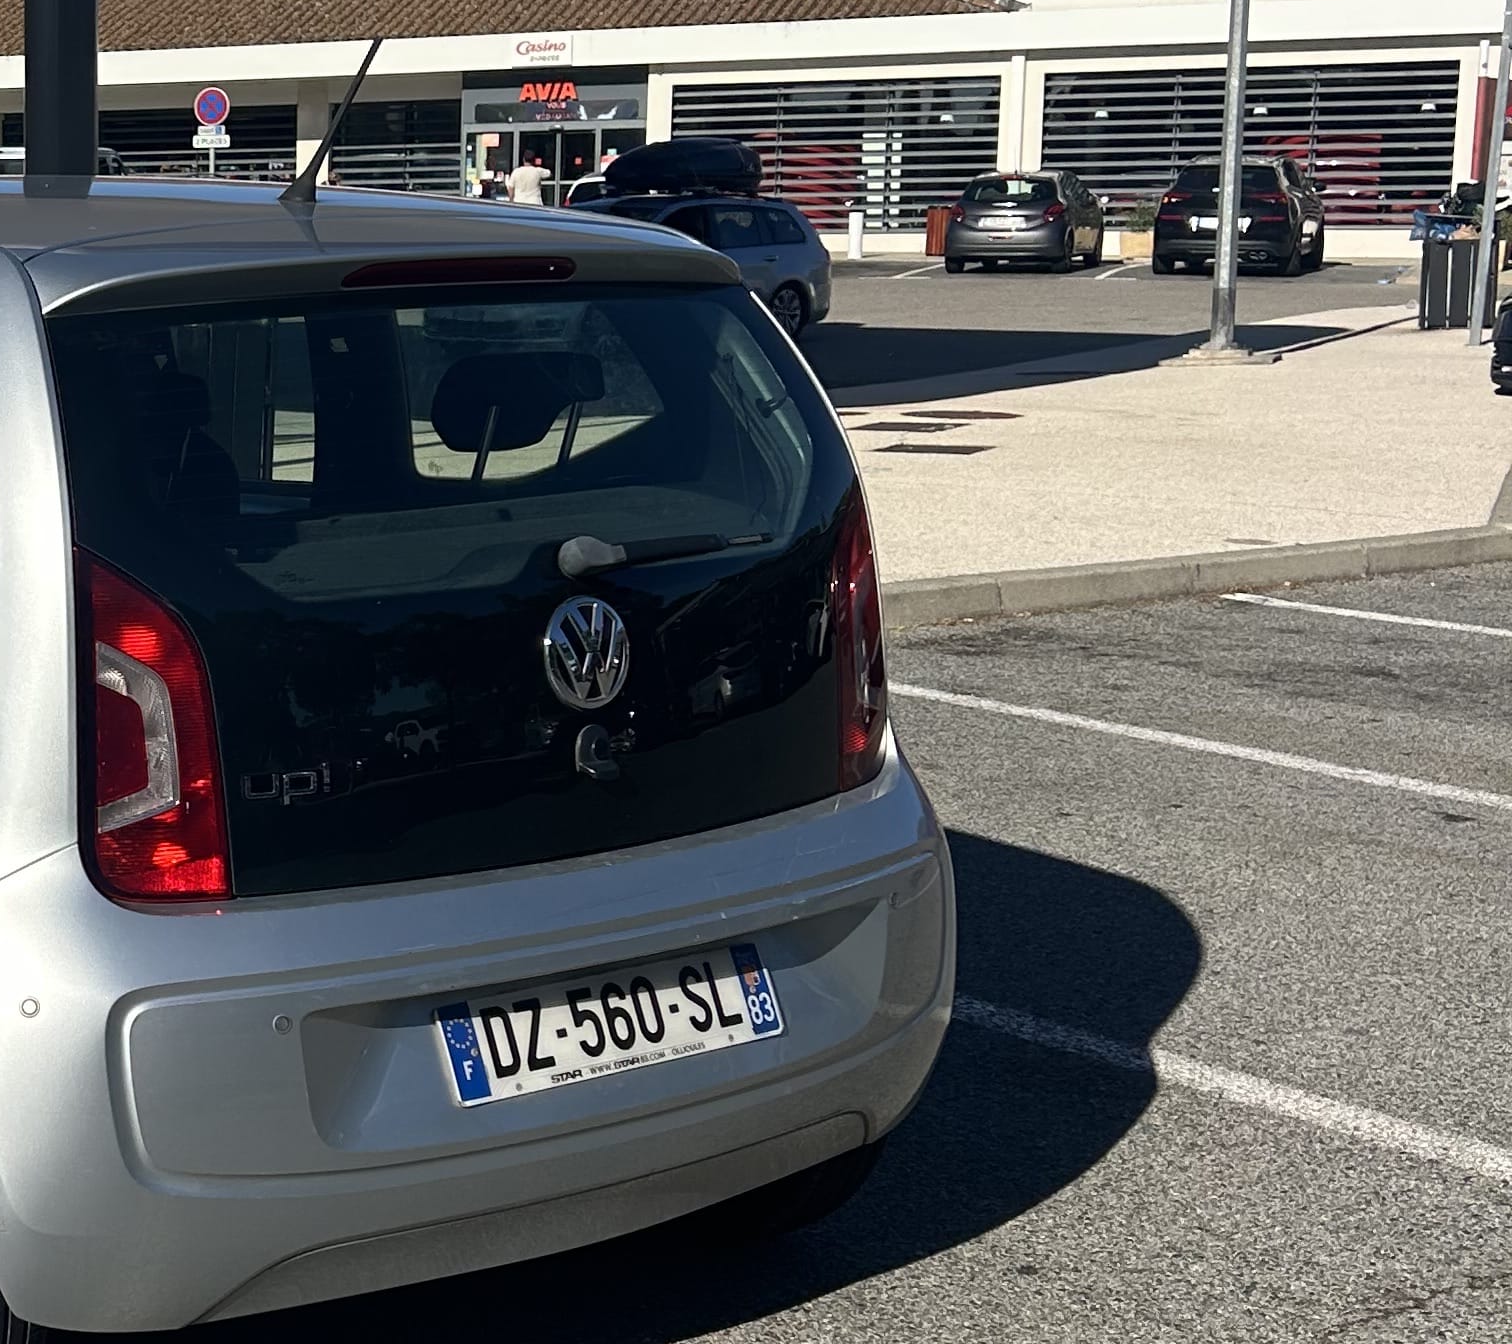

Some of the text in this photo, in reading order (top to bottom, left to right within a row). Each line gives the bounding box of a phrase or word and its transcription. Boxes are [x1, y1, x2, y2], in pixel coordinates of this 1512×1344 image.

[516, 40, 567, 56] Casino
[519, 82, 578, 102] AVIA
[746, 992, 775, 1026] 83
[462, 1059, 474, 1081] F
[551, 1069, 583, 1084] STAR
